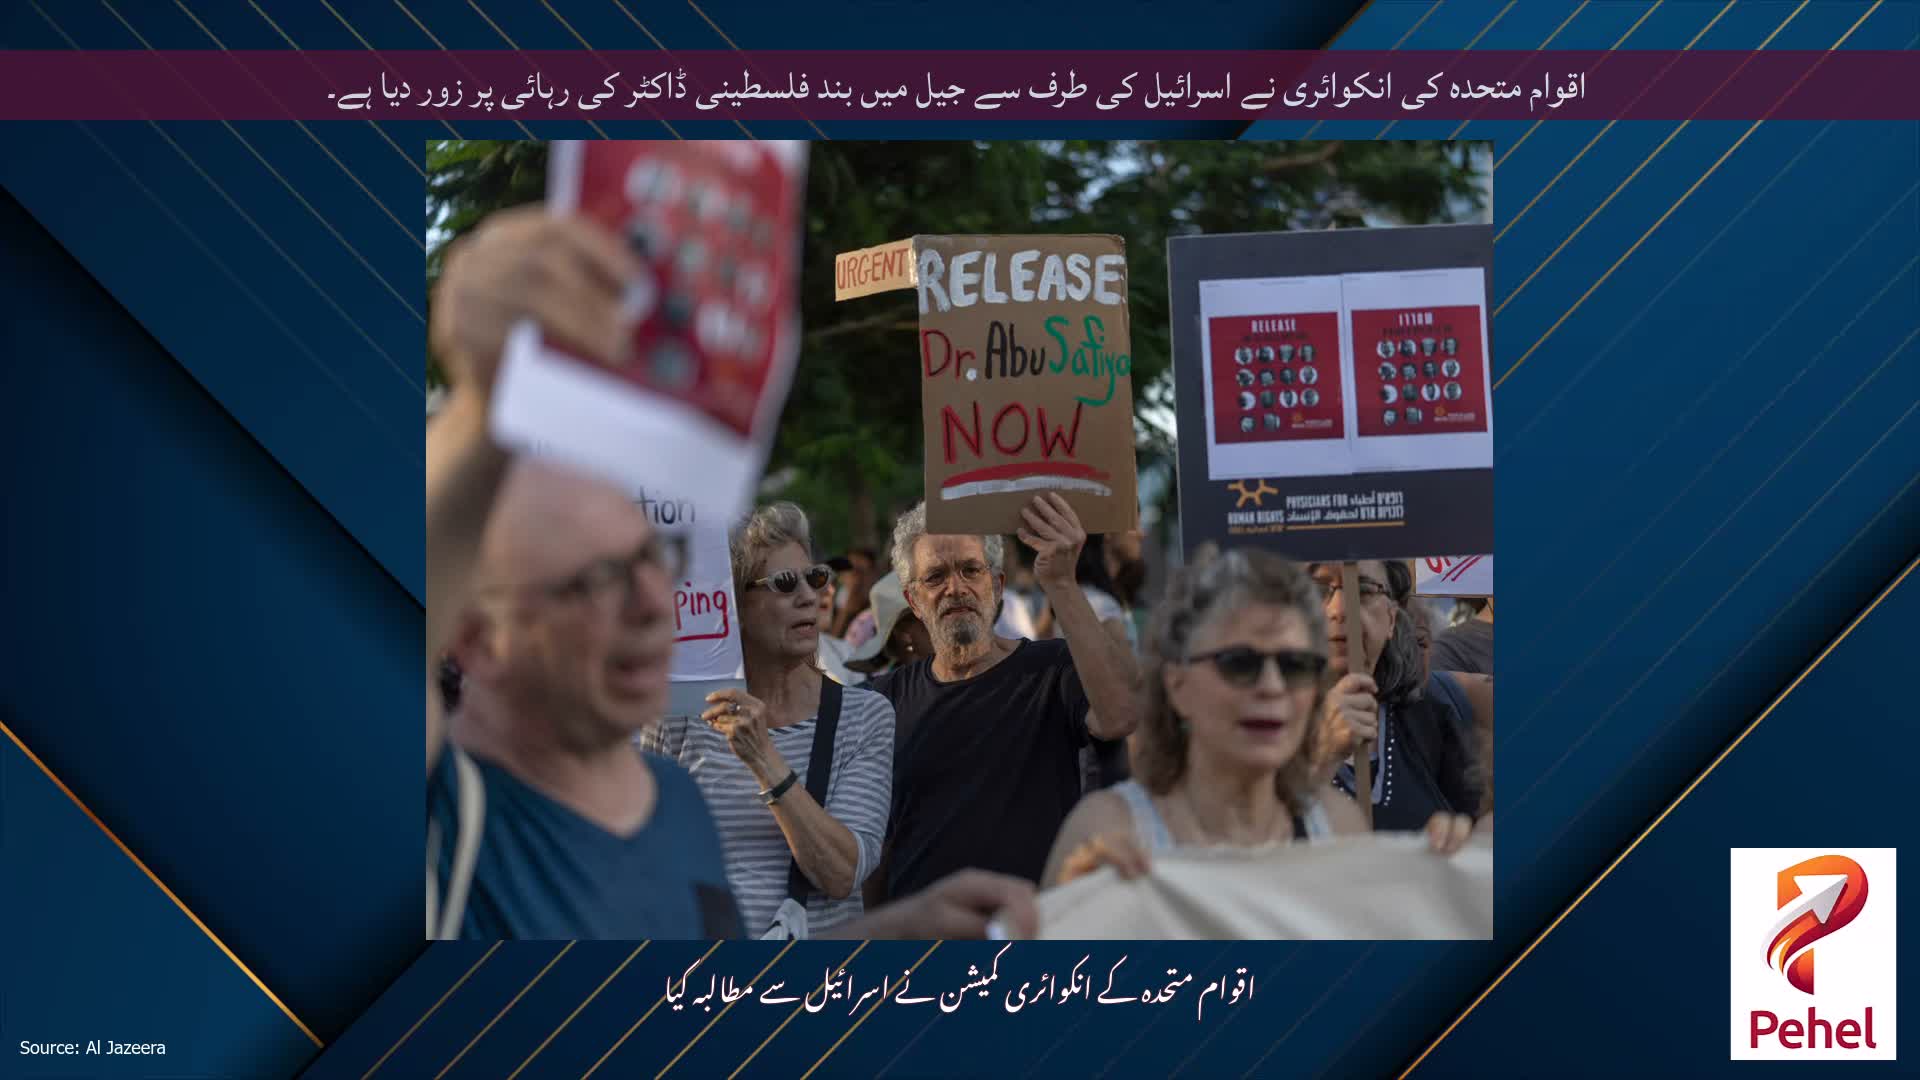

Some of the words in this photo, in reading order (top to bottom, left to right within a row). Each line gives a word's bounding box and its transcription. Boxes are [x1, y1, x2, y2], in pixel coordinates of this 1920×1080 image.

[836, 248, 909, 290] URGENT
[917, 248, 1127, 315] RELEASE
[921, 328, 977, 381] Dr.
[985, 321, 1045, 379] Abu
[1251, 318, 1296, 333] RELEASE
[941, 400, 1084, 464] NOW
[633, 485, 696, 525] tion
[672, 582, 729, 638] ping
